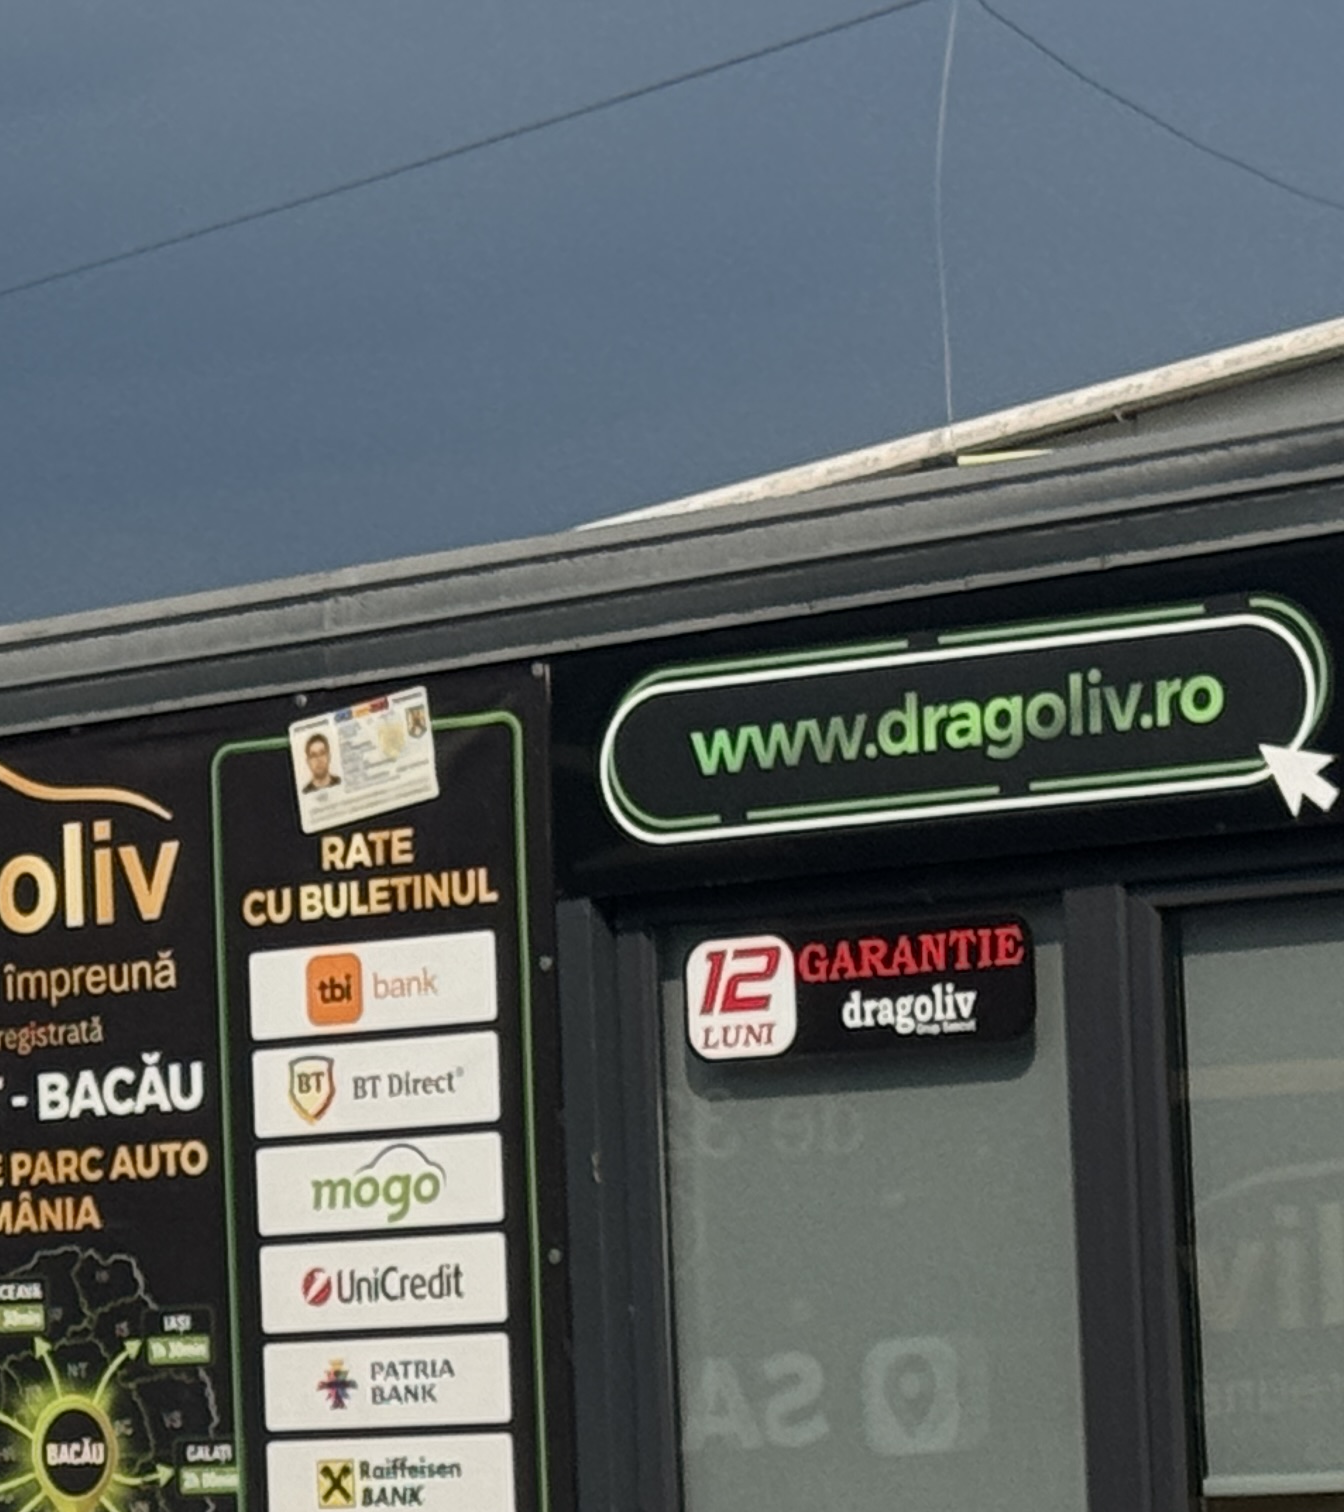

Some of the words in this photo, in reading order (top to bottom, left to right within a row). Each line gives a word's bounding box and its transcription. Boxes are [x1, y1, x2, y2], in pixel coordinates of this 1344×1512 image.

[690, 669, 1226, 776] www.dragoliv.ro
[320, 828, 414, 871] RATE
[241, 890, 292, 927] CU
[298, 868, 499, 922] BULETINUL
[797, 923, 1026, 983] GARANTIE
[4, 949, 178, 1008] împreună
[318, 973, 353, 1004] tbi
[372, 966, 439, 1000] bank
[699, 945, 781, 1018] 12
[841, 982, 978, 1034] dragoliv
[700, 1022, 778, 1051] LUNI
[36, 1051, 204, 1121] BACĂU
[296, 1070, 325, 1095] BT
[352, 1073, 382, 1100] BT
[10, 1147, 105, 1187] PARC
[111, 1140, 210, 1181] AUTO
[312, 1169, 442, 1223] mogo
[336, 1263, 464, 1304] UniCredit
[370, 1358, 456, 1382] PATRIA
[371, 1383, 438, 1406] BANK
[45, 1436, 106, 1466] BACĂU
[359, 1456, 463, 1482] Raiffeisen
[362, 1484, 425, 1508] BANK
